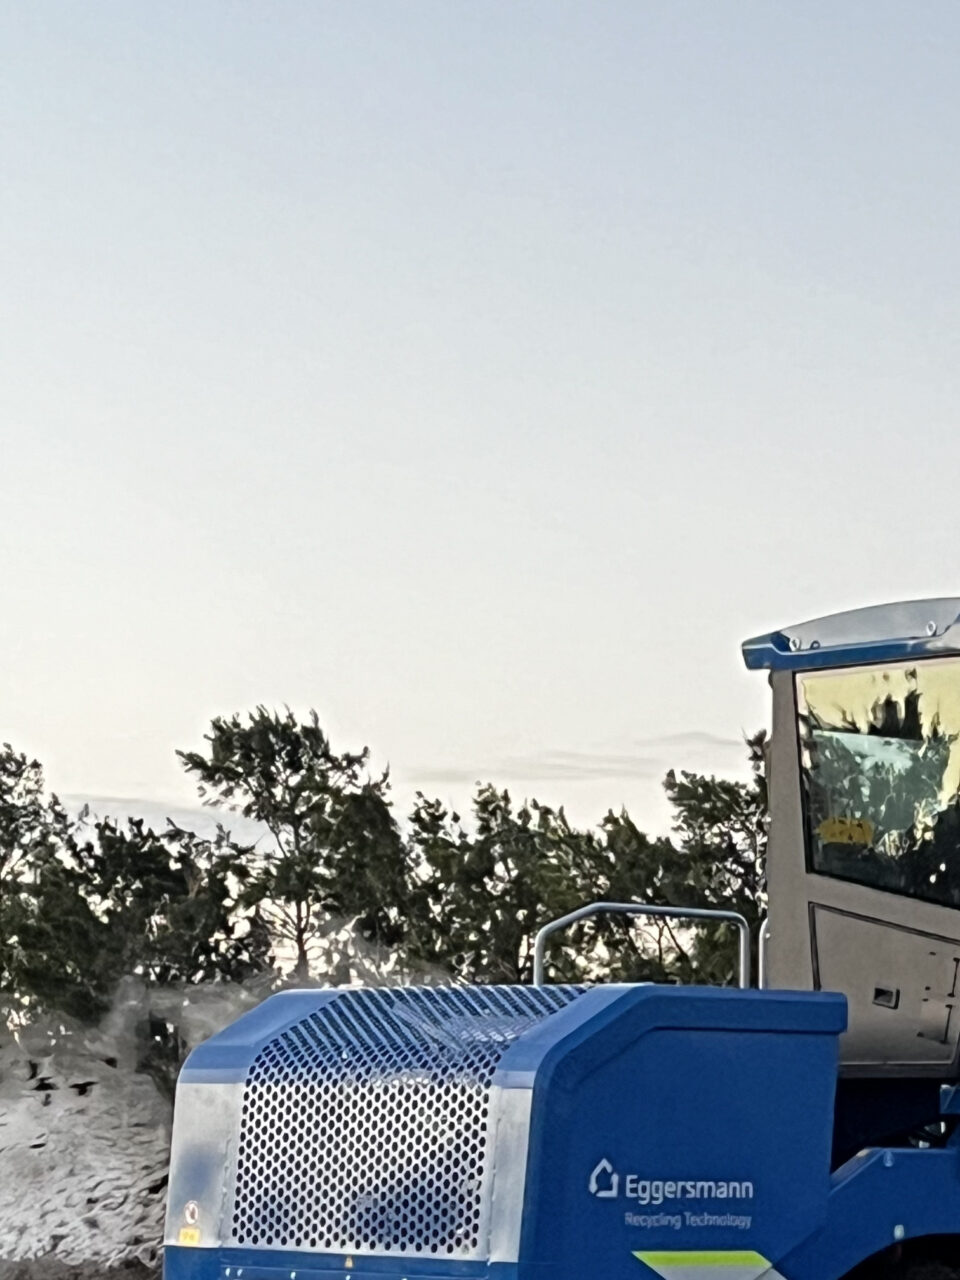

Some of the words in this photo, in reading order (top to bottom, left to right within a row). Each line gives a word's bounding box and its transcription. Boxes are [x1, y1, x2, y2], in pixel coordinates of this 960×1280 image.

[625, 1174, 754, 1205] Eggersmann
[624, 1212, 682, 1230] Recycling
[684, 1212, 752, 1230] Technology
